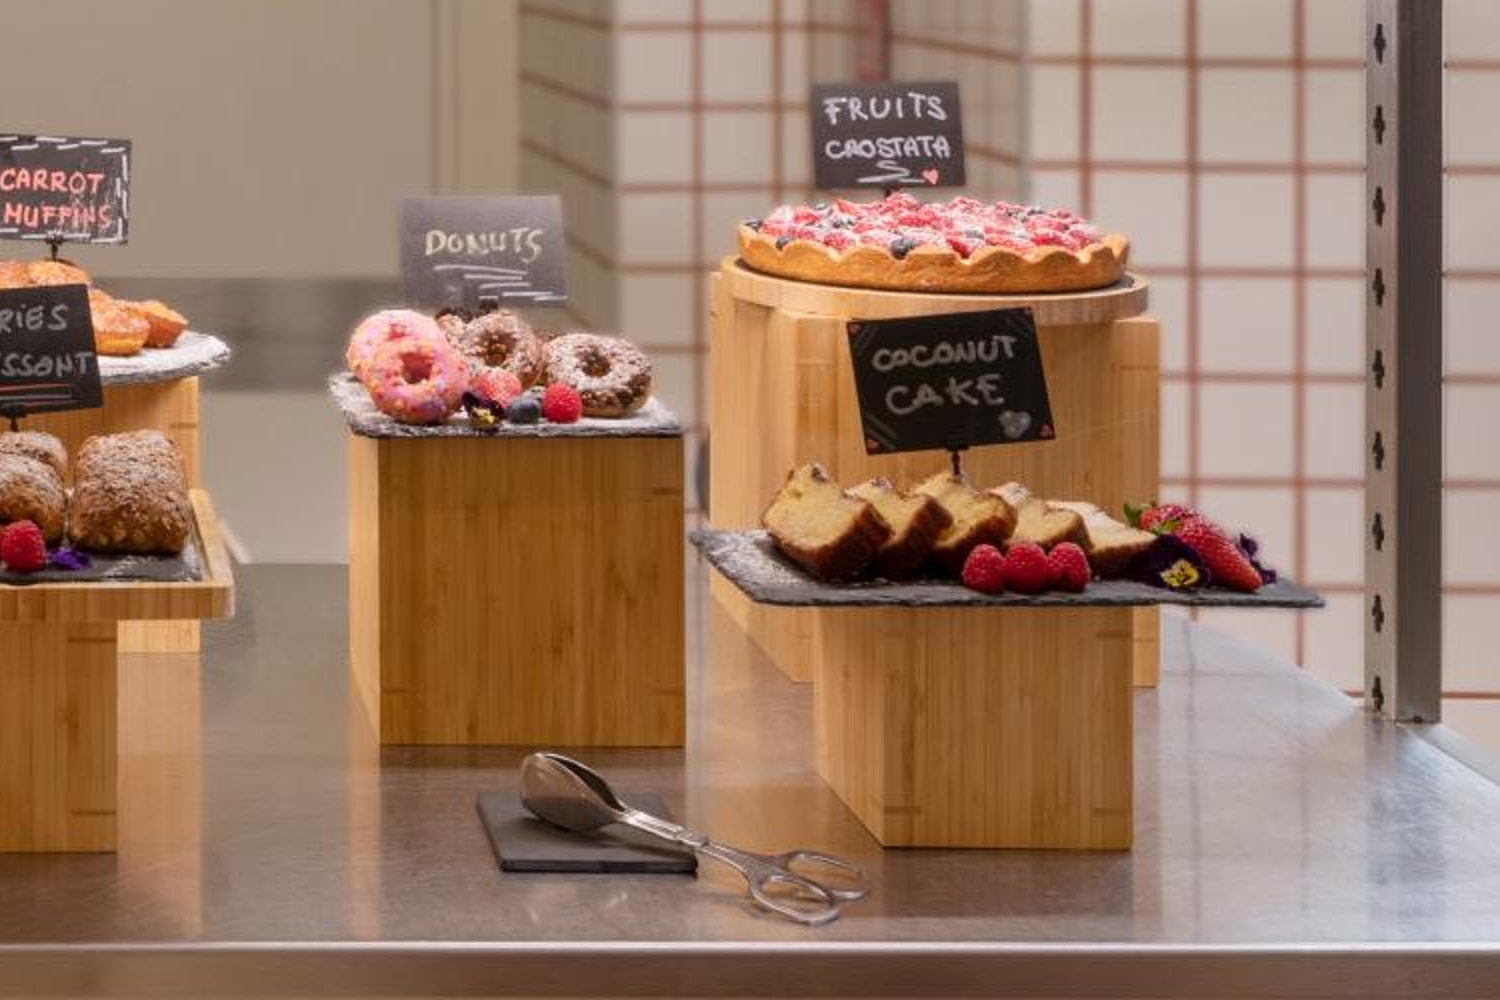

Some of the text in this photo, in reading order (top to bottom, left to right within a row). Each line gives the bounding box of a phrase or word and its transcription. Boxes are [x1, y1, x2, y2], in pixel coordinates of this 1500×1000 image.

[823, 92, 948, 125] FRUITS
[0, 168, 104, 194] CARROT
[425, 227, 543, 264] DONUTS
[871, 335, 1017, 371] COCONUT
[885, 373, 1004, 415] CAKE
